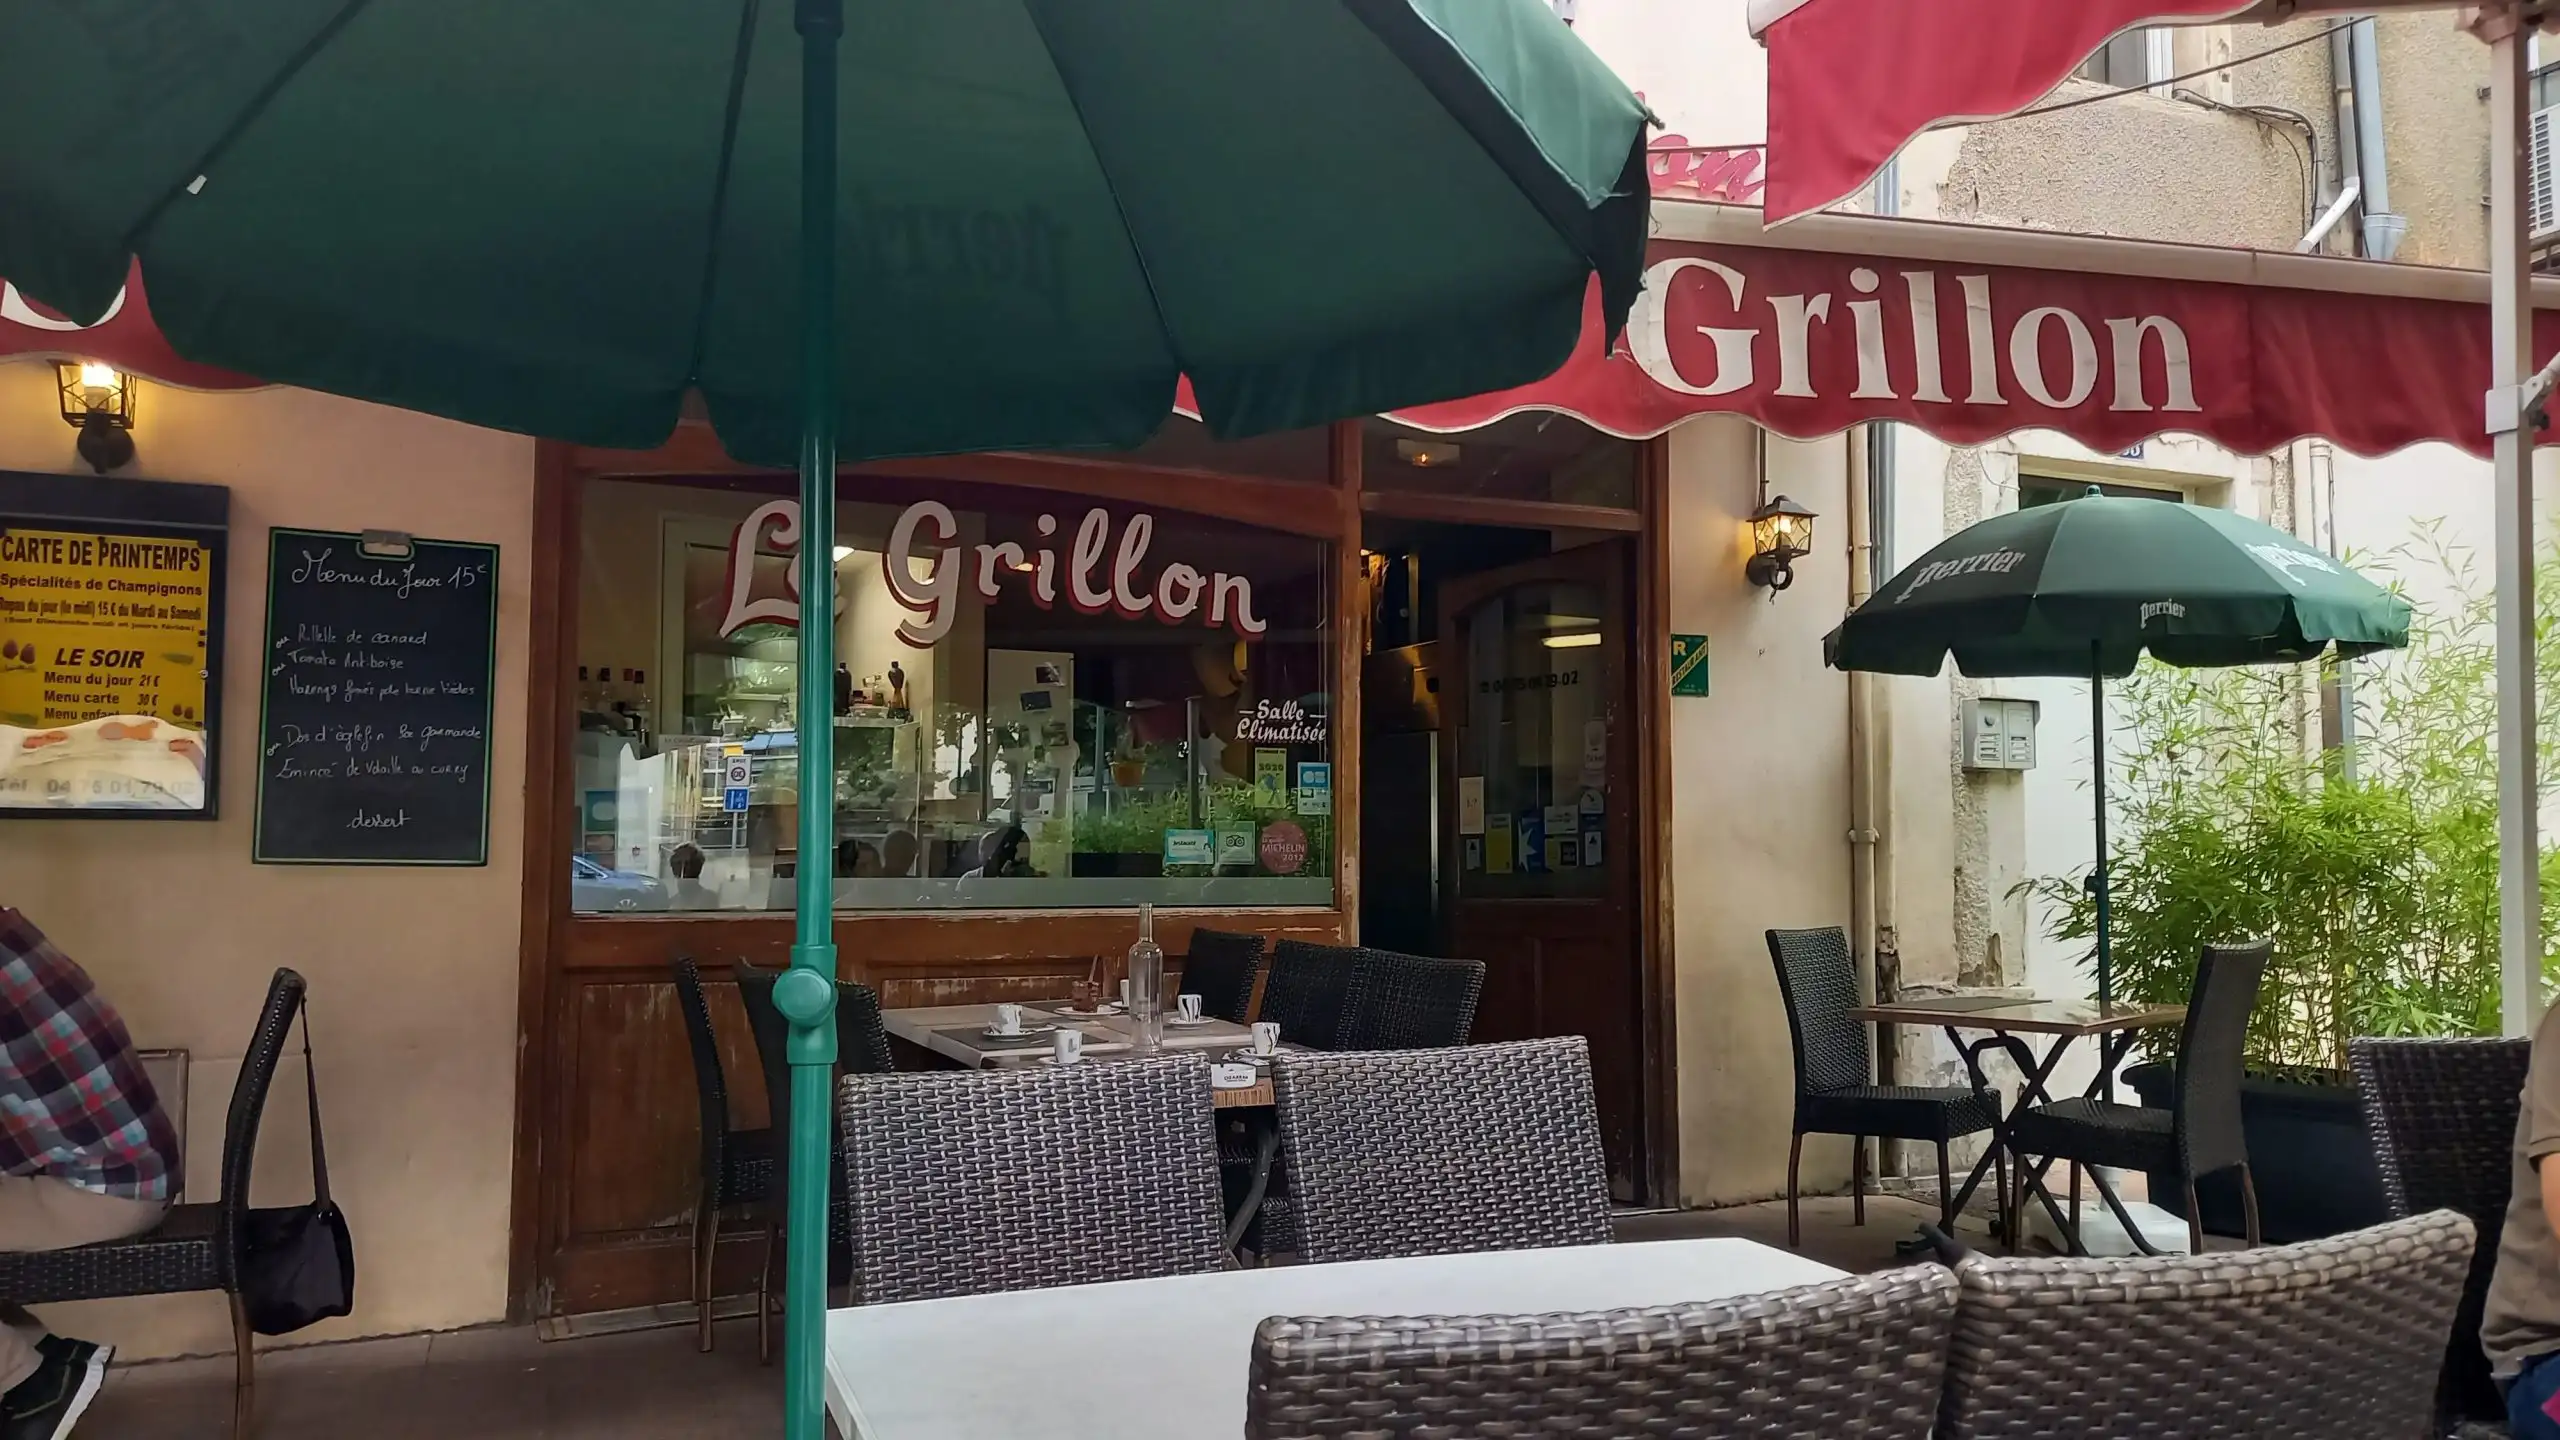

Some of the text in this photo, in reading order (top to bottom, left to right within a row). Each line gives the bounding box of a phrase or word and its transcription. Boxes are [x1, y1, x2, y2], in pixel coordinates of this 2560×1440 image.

[1626, 257, 2202, 413] Grillon
[2, 536, 201, 572] CARTE DE PRINTEMPS
[291, 547, 366, 583] Menu
[370, 568, 398, 586] du
[882, 500, 1267, 648] Grillon
[0, 573, 202, 597] Spécialités de Champignons
[55, 647, 145, 669] LE SOIR
[1673, 640, 1687, 656] R
[44, 671, 81, 684] Menu
[85, 673, 102, 685] du
[106, 673, 135, 688] jour
[44, 689, 80, 703] Menu
[84, 693, 119, 704] carte
[44, 707, 78, 720] Menu
[1235, 717, 1326, 741] Climatisée
[1258, 763, 1284, 772] 2020
[1262, 843, 1305, 853] MICHELIN
